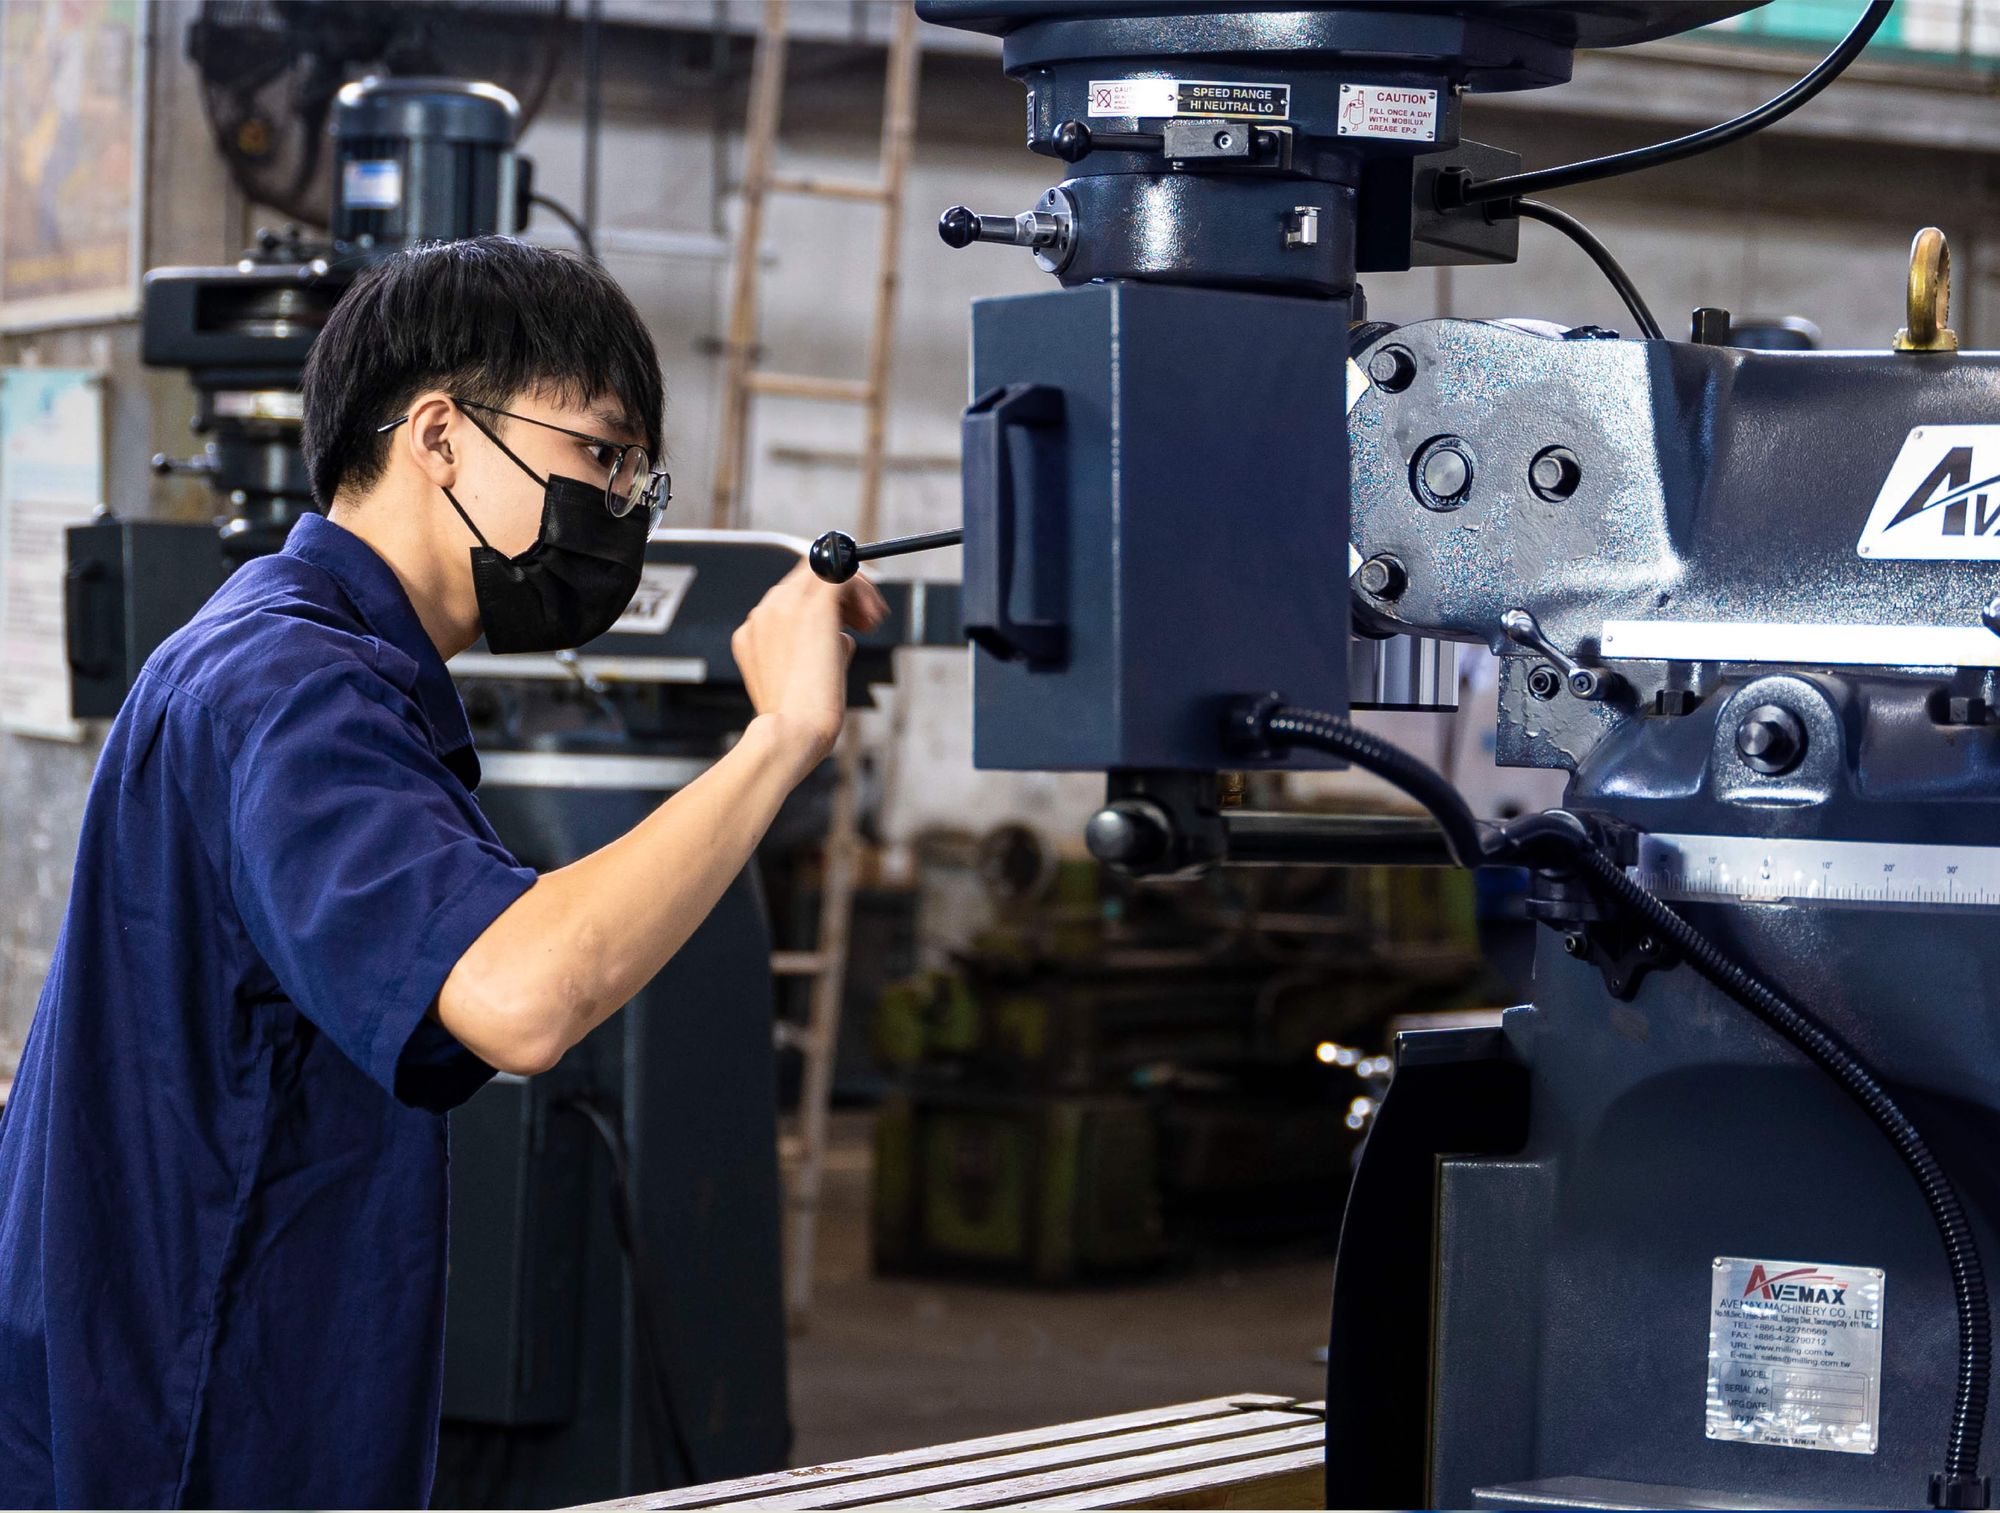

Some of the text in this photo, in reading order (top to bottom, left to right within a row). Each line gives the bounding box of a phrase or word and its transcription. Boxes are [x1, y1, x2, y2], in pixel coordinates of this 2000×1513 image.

[1193, 87, 1272, 100] SPEED RANGE
[1377, 92, 1426, 104] CAUTION
[1190, 100, 1274, 113] HI NEUTRAL LO
[1369, 107, 1384, 115] FILL
[1387, 108, 1408, 117] ONCE
[1368, 116, 1424, 126] WITH MOBILUX
[1368, 124, 1417, 134] GREASE EP-2
[1882, 447, 2000, 536] AV
[1743, 1264, 1848, 1306] AVEMAX
[1765, 1302, 1827, 1317] MACHINERY
